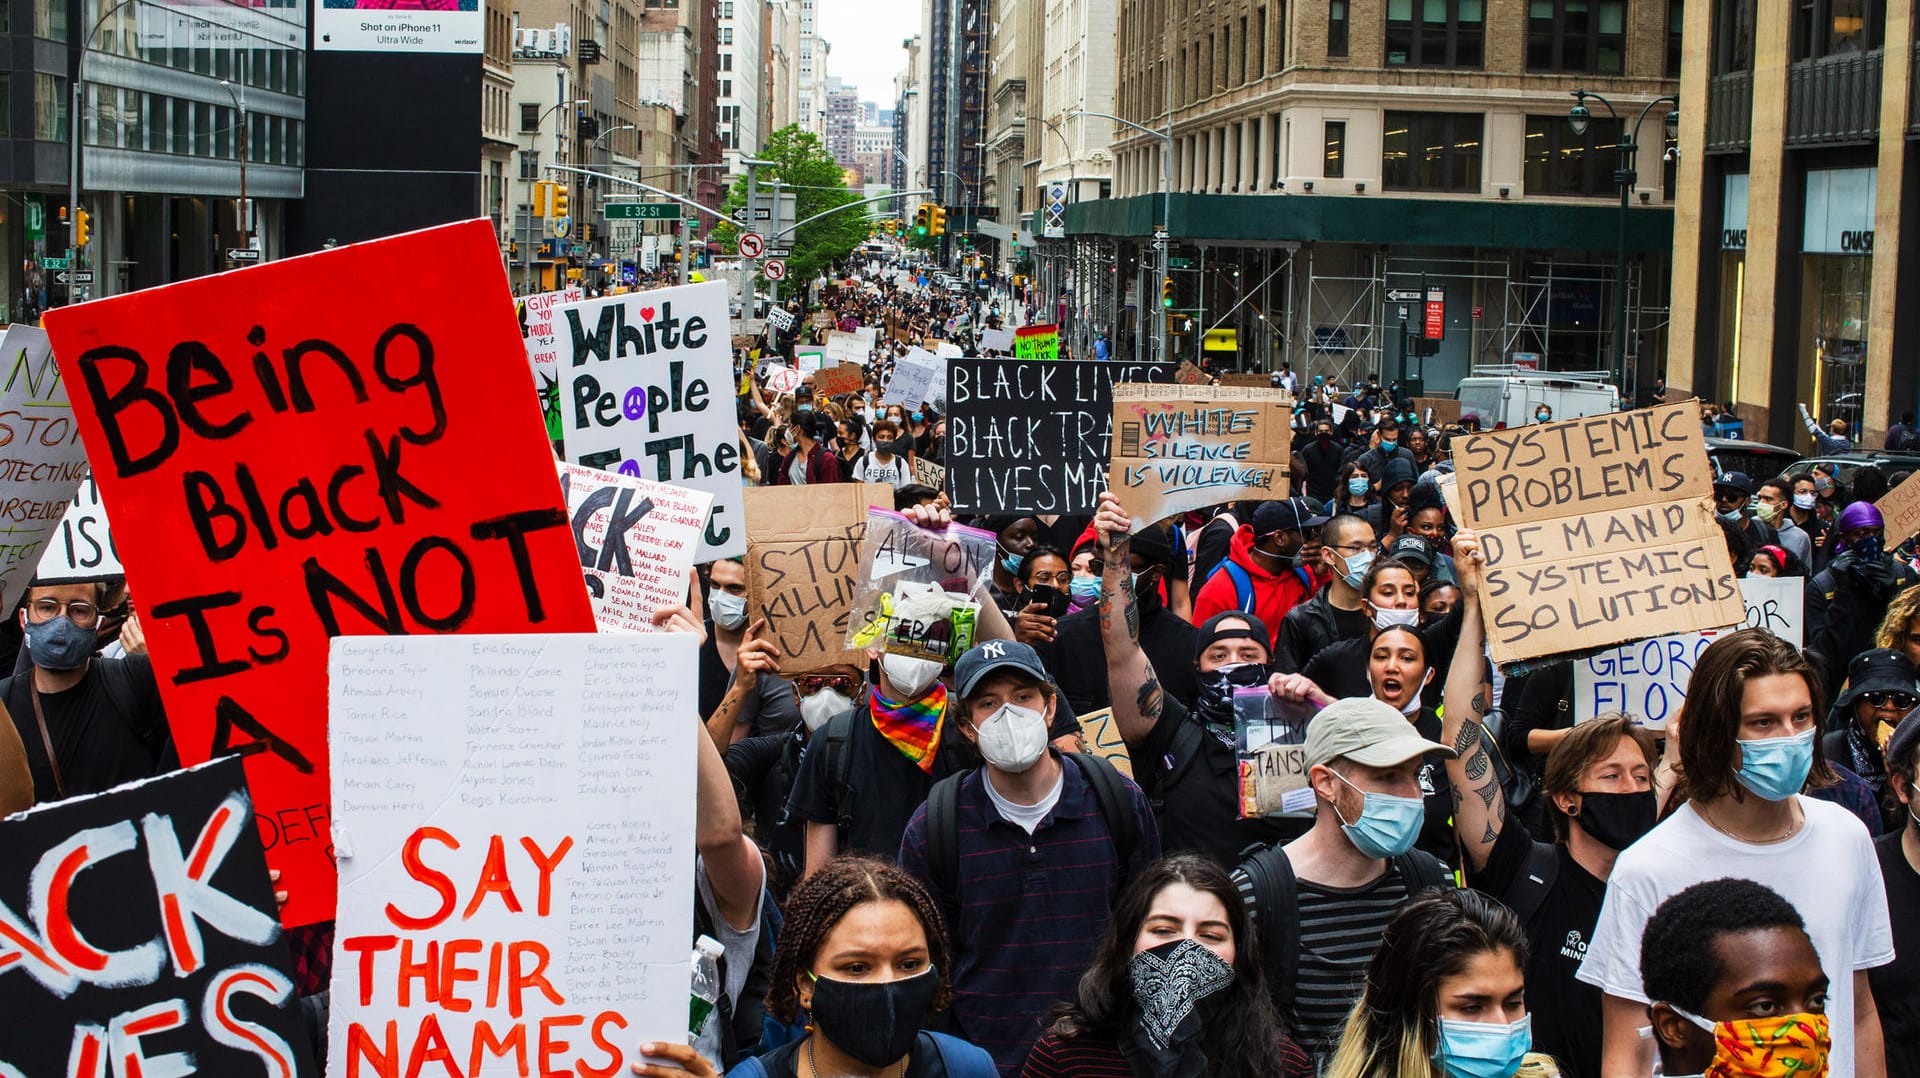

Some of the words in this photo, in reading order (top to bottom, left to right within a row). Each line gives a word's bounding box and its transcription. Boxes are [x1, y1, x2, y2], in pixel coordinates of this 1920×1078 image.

[360, 22, 383, 31] Shot
[399, 22, 431, 32] iPhone
[377, 36, 398, 44] Ultra
[400, 36, 424, 44] Wide
[625, 206, 632, 216] E
[634, 206, 648, 216] 32
[649, 205, 661, 217] St
[565, 301, 710, 367] White
[1020, 341, 1032, 351] NO
[573, 361, 710, 433] People
[954, 364, 1058, 403] BLACK
[78, 322, 449, 478] Being
[953, 415, 1043, 460] BLACK
[1144, 408, 1259, 438] WHITE
[1143, 440, 1251, 460] SILENCE
[1464, 409, 1689, 472] SYSTEMIC
[645, 433, 739, 483] The
[866, 468, 897, 478] REBEL
[950, 464, 1057, 511] LIVES
[1124, 462, 1151, 488] IS
[1469, 453, 1686, 521] PROBLEMS
[183, 427, 441, 563] Black
[561, 473, 656, 578] CK
[631, 522, 657, 535] AILEY
[648, 510, 670, 522] ERIC
[670, 513, 703, 531] GARNER
[635, 547, 668, 563] MALLARD
[654, 564, 682, 578] GREEN
[1486, 545, 1710, 596] SYSTEMIC
[151, 589, 291, 686] Is
[302, 507, 568, 637] NOT
[611, 585, 641, 599] RONALD
[614, 575, 637, 588] TONY
[638, 581, 680, 601] ROBINSON
[610, 595, 634, 609] SEAN
[635, 602, 656, 615] BEL
[1495, 573, 1736, 644] SOLUTIONS
[1739, 599, 1790, 632] OR
[472, 642, 498, 656] Eric
[501, 642, 544, 657] Garner
[861, 610, 967, 660] STERLIG
[343, 642, 381, 662] George
[981, 641, 1006, 660] NY
[381, 705, 408, 720] Rice
[208, 695, 315, 773] A
[500, 775, 536, 786] Jones
[385, 826, 575, 930] SAY
[582, 861, 619, 874] Warren
[343, 935, 566, 1018] THEIR
[346, 1009, 630, 1078] NAMES
